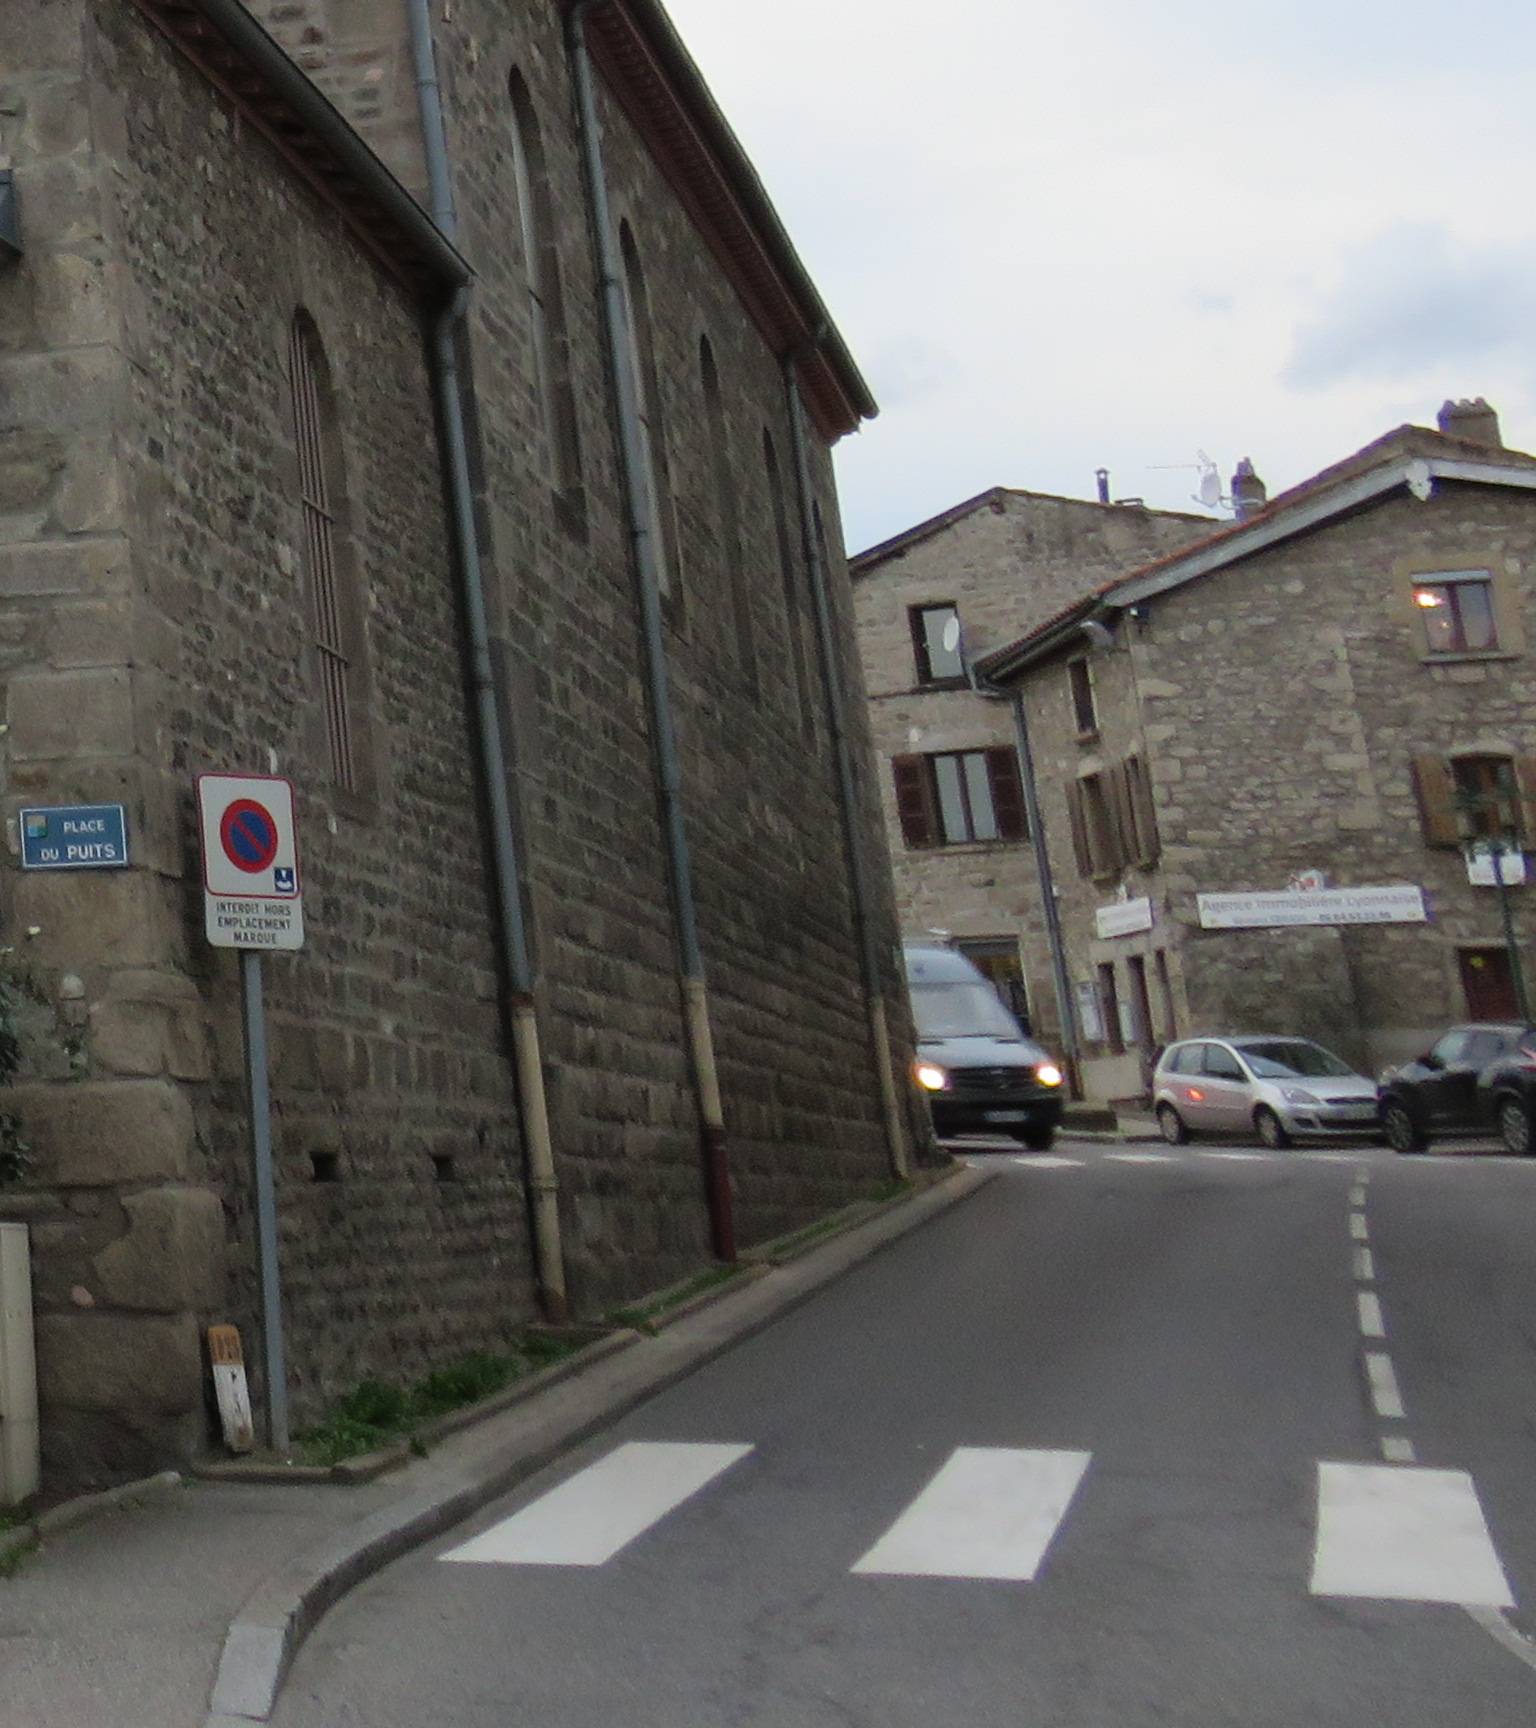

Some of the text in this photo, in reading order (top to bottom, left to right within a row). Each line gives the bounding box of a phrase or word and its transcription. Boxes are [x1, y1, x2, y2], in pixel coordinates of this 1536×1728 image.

[63, 819, 105, 833] PLACE
[40, 843, 116, 861] DU PUITS
[216, 901, 292, 916] INTERDIT HORS
[217, 916, 291, 930] EMPLACEMENT
